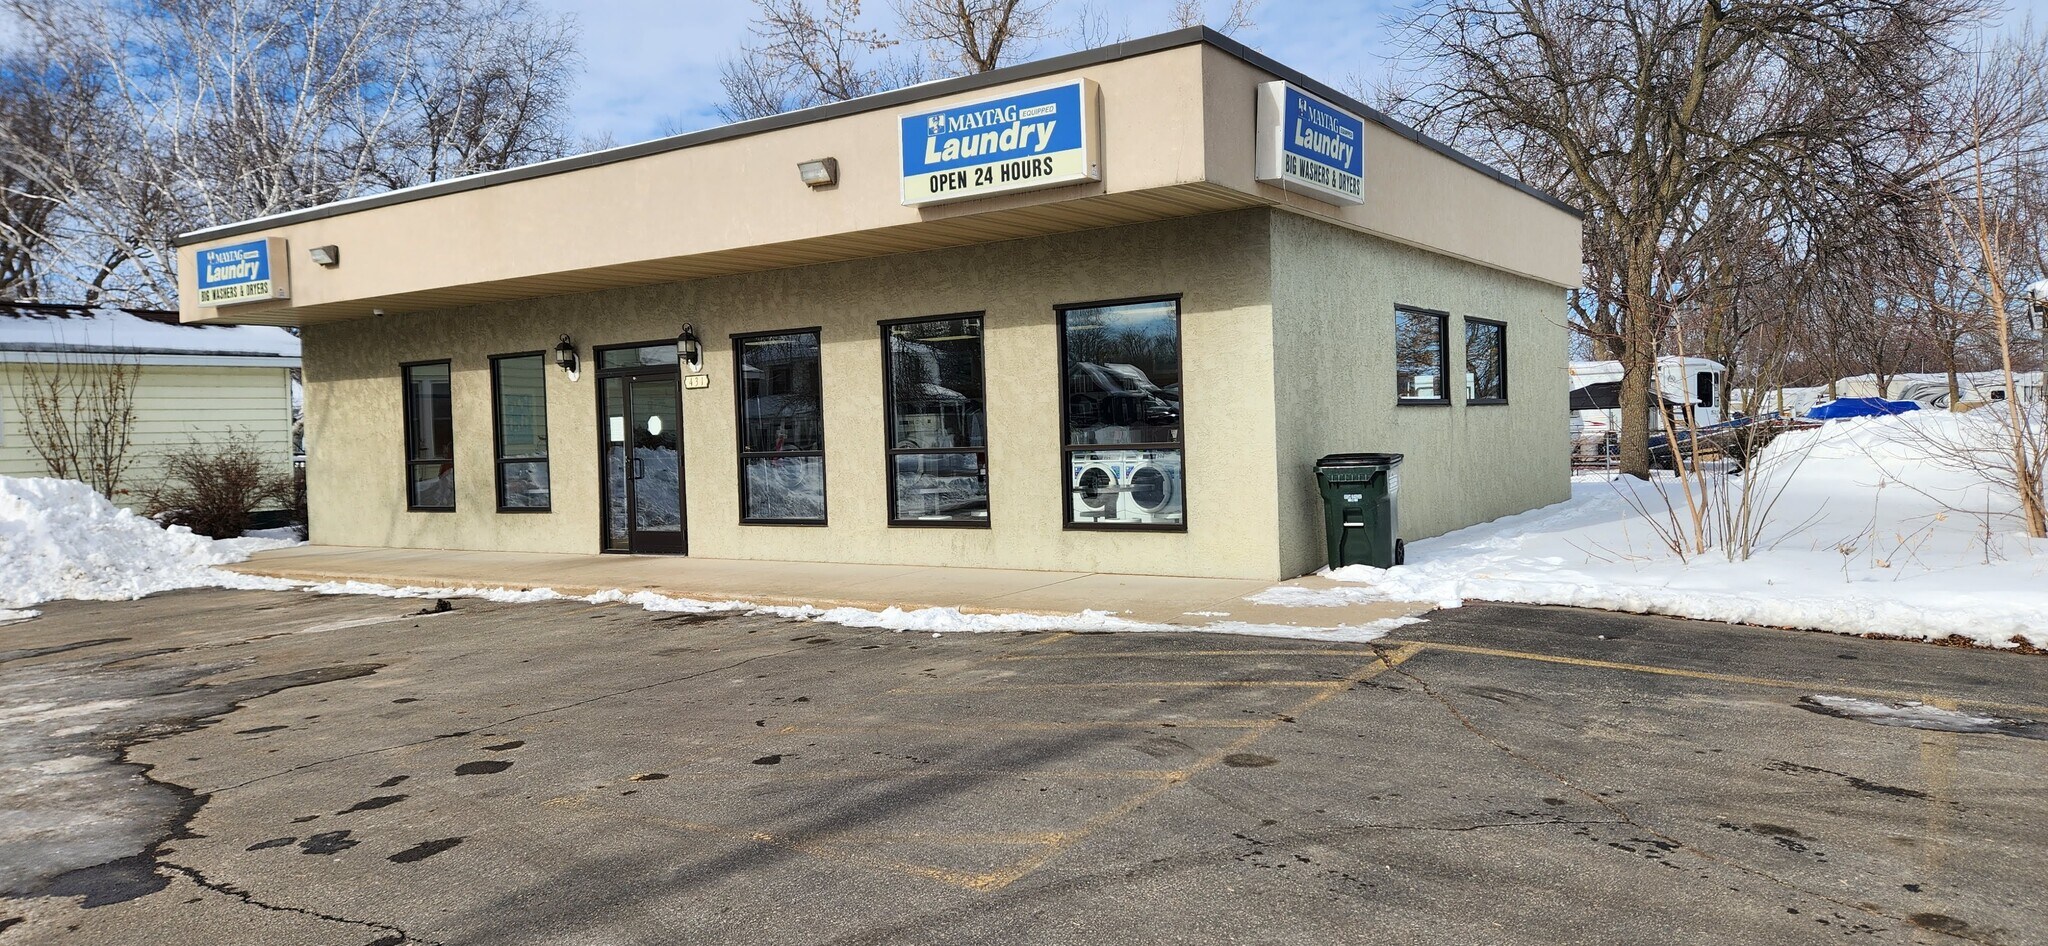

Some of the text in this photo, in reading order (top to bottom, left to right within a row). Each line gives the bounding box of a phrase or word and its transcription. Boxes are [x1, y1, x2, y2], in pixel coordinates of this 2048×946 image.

[948, 105, 1055, 133] MAYTAG EQUIPPED
[1308, 106, 1338, 133] MAYTAG
[924, 120, 1057, 165] Laundry
[1295, 118, 1353, 169] Laundry
[930, 156, 1054, 194] OPEN 24 HOURS
[1285, 153, 1360, 195] BIG WASHERS & DRYERS
[215, 249, 243, 263] MAYTAG
[206, 260, 259, 282] Laundry
[213, 286, 238, 301] WASHERS
[246, 282, 268, 295] DRYERS
